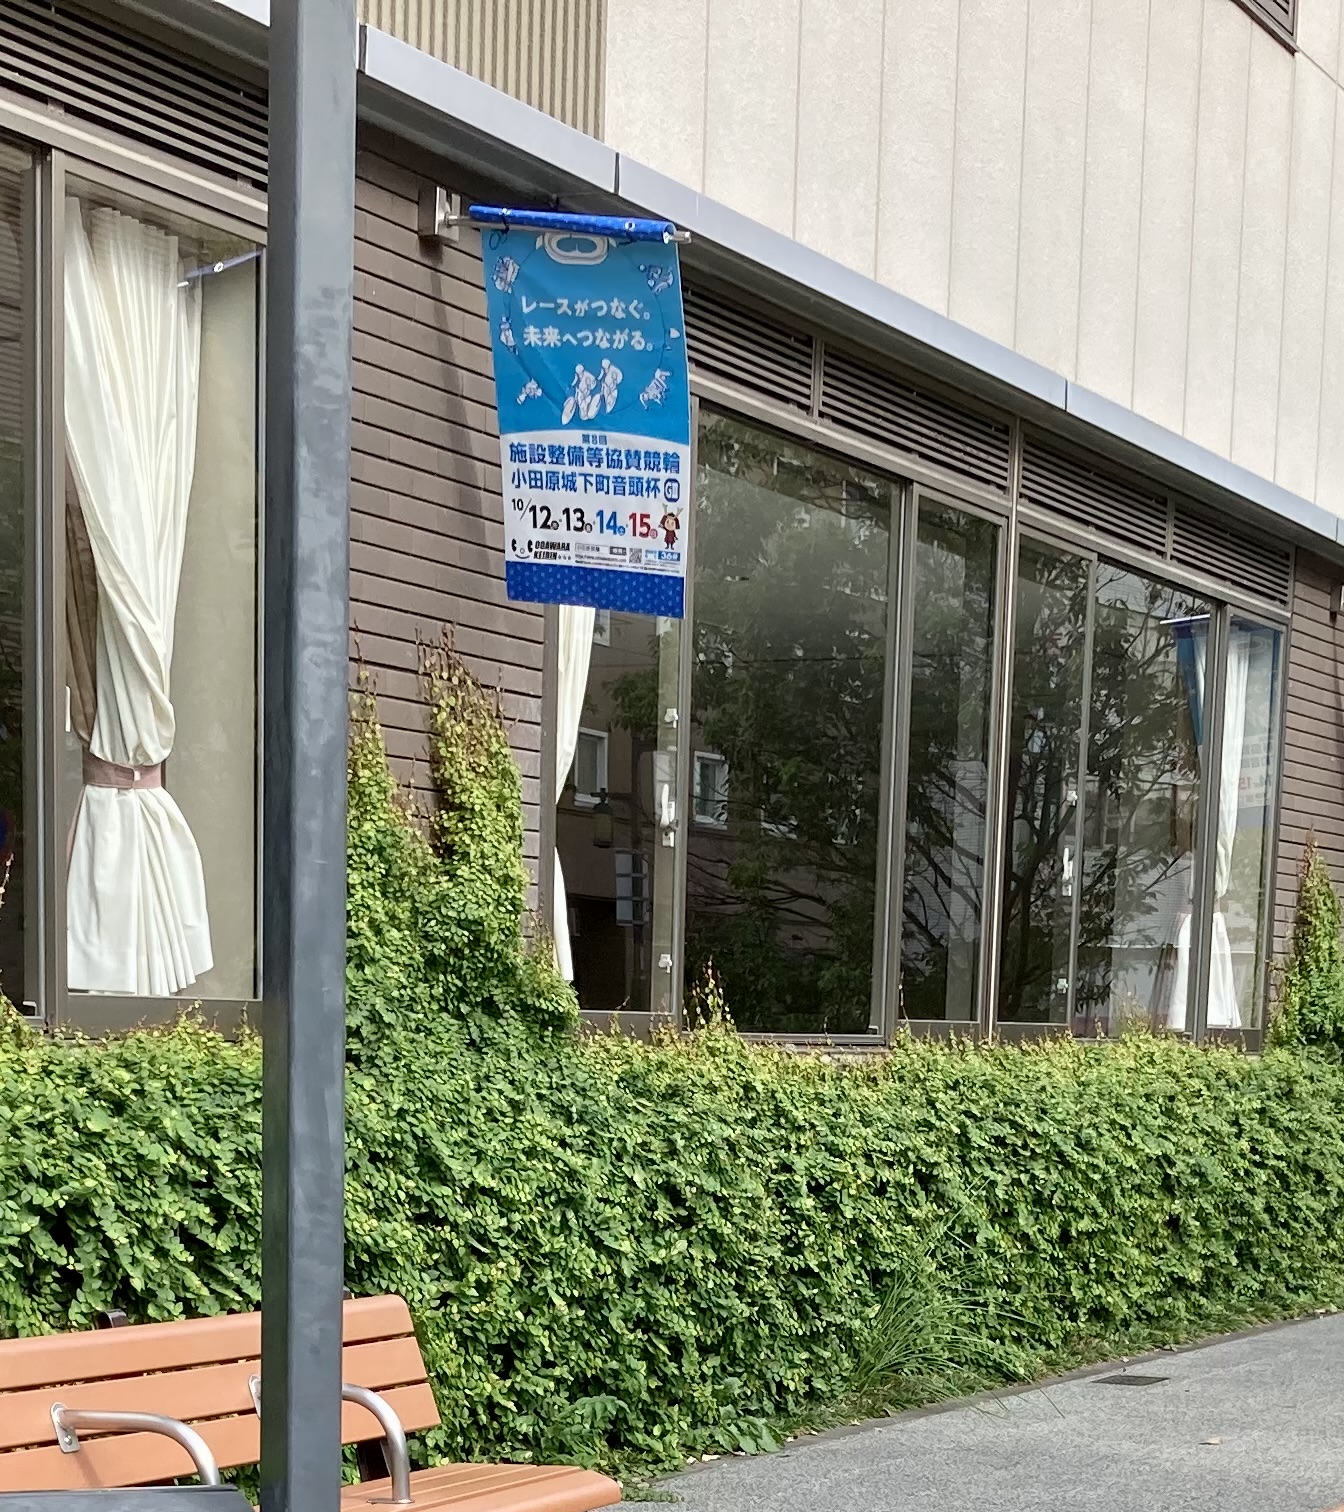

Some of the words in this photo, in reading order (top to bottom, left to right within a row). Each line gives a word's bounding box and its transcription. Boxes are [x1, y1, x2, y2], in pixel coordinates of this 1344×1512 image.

[521, 295, 651, 321] レースがつなぐ。
[523, 325, 654, 352] 未来へつながる。
[509, 441, 680, 475] 施設整備等協賛競輪
[511, 467, 661, 500] 小田原城下町音頭杯
